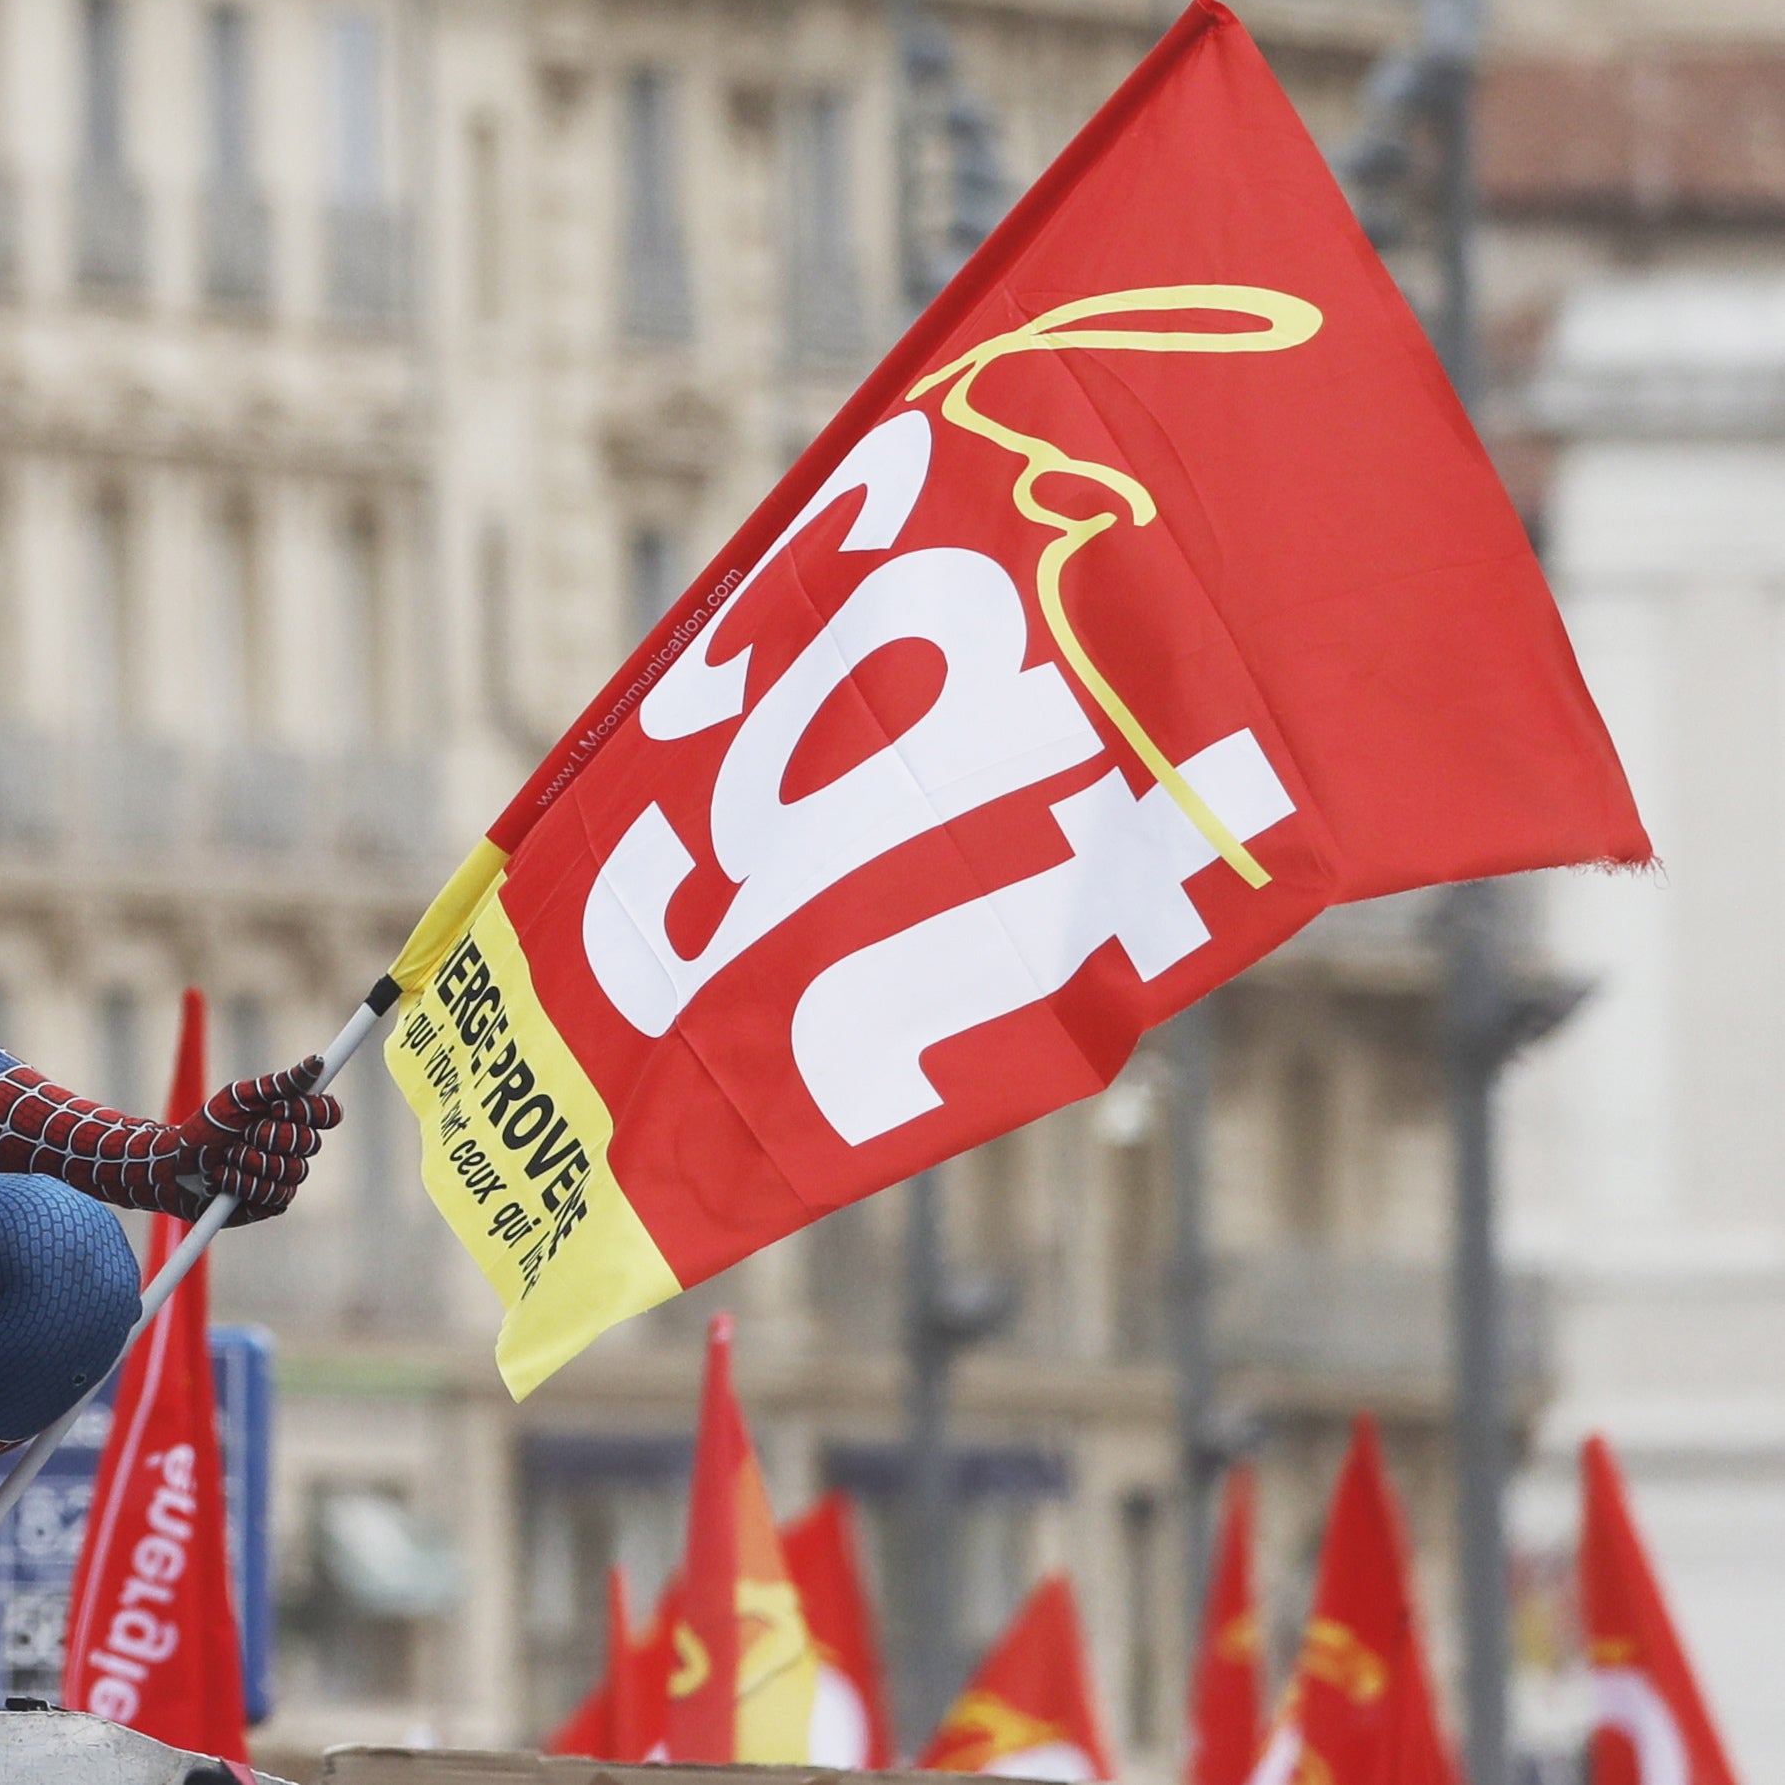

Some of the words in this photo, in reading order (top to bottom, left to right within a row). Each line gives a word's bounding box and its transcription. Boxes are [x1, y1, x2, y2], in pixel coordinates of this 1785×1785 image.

[535, 567, 743, 807] www.LMcommunication.com
[581, 408, 1298, 1147] cgt
[904, 283, 1324, 890] la
[400, 1012, 444, 1057] qui
[449, 1138, 508, 1205] ceux
[487, 1201, 542, 1249] qui
